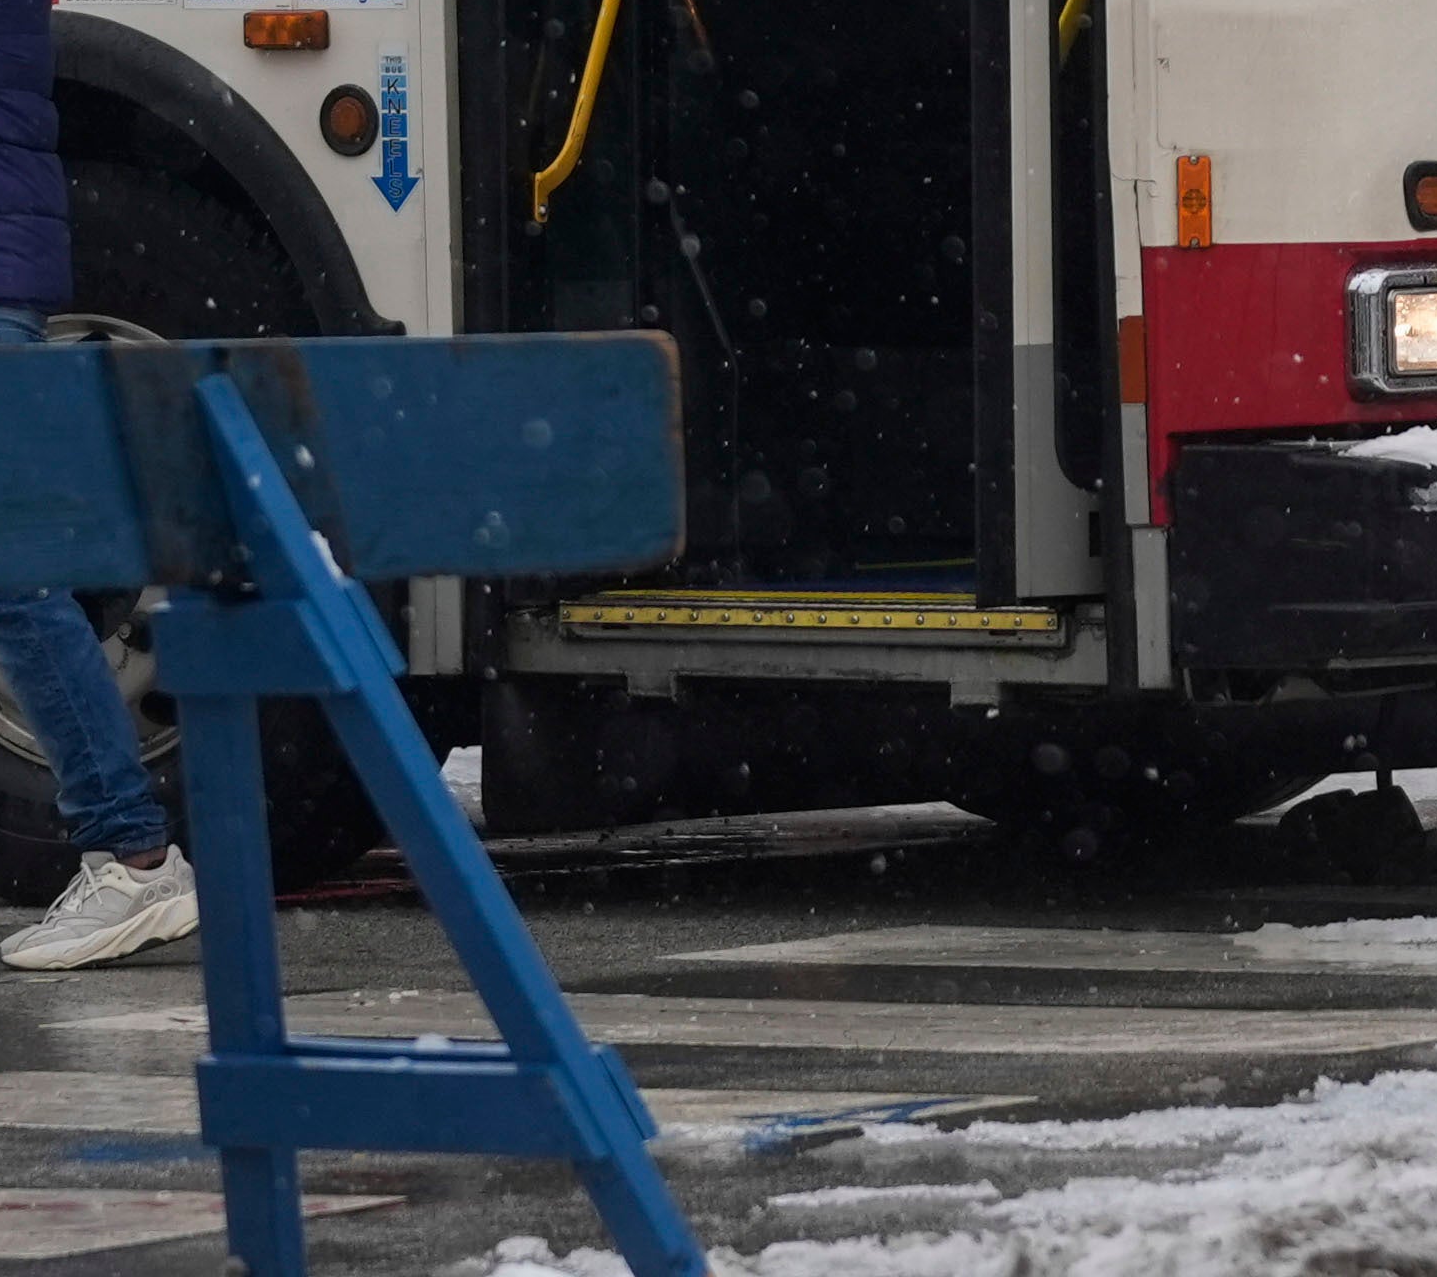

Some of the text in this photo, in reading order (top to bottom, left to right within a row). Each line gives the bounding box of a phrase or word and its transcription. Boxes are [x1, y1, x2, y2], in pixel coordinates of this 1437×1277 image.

[384, 56, 403, 64] THIS
[384, 65, 404, 74] BUS
[387, 79, 404, 202] KNEELS
